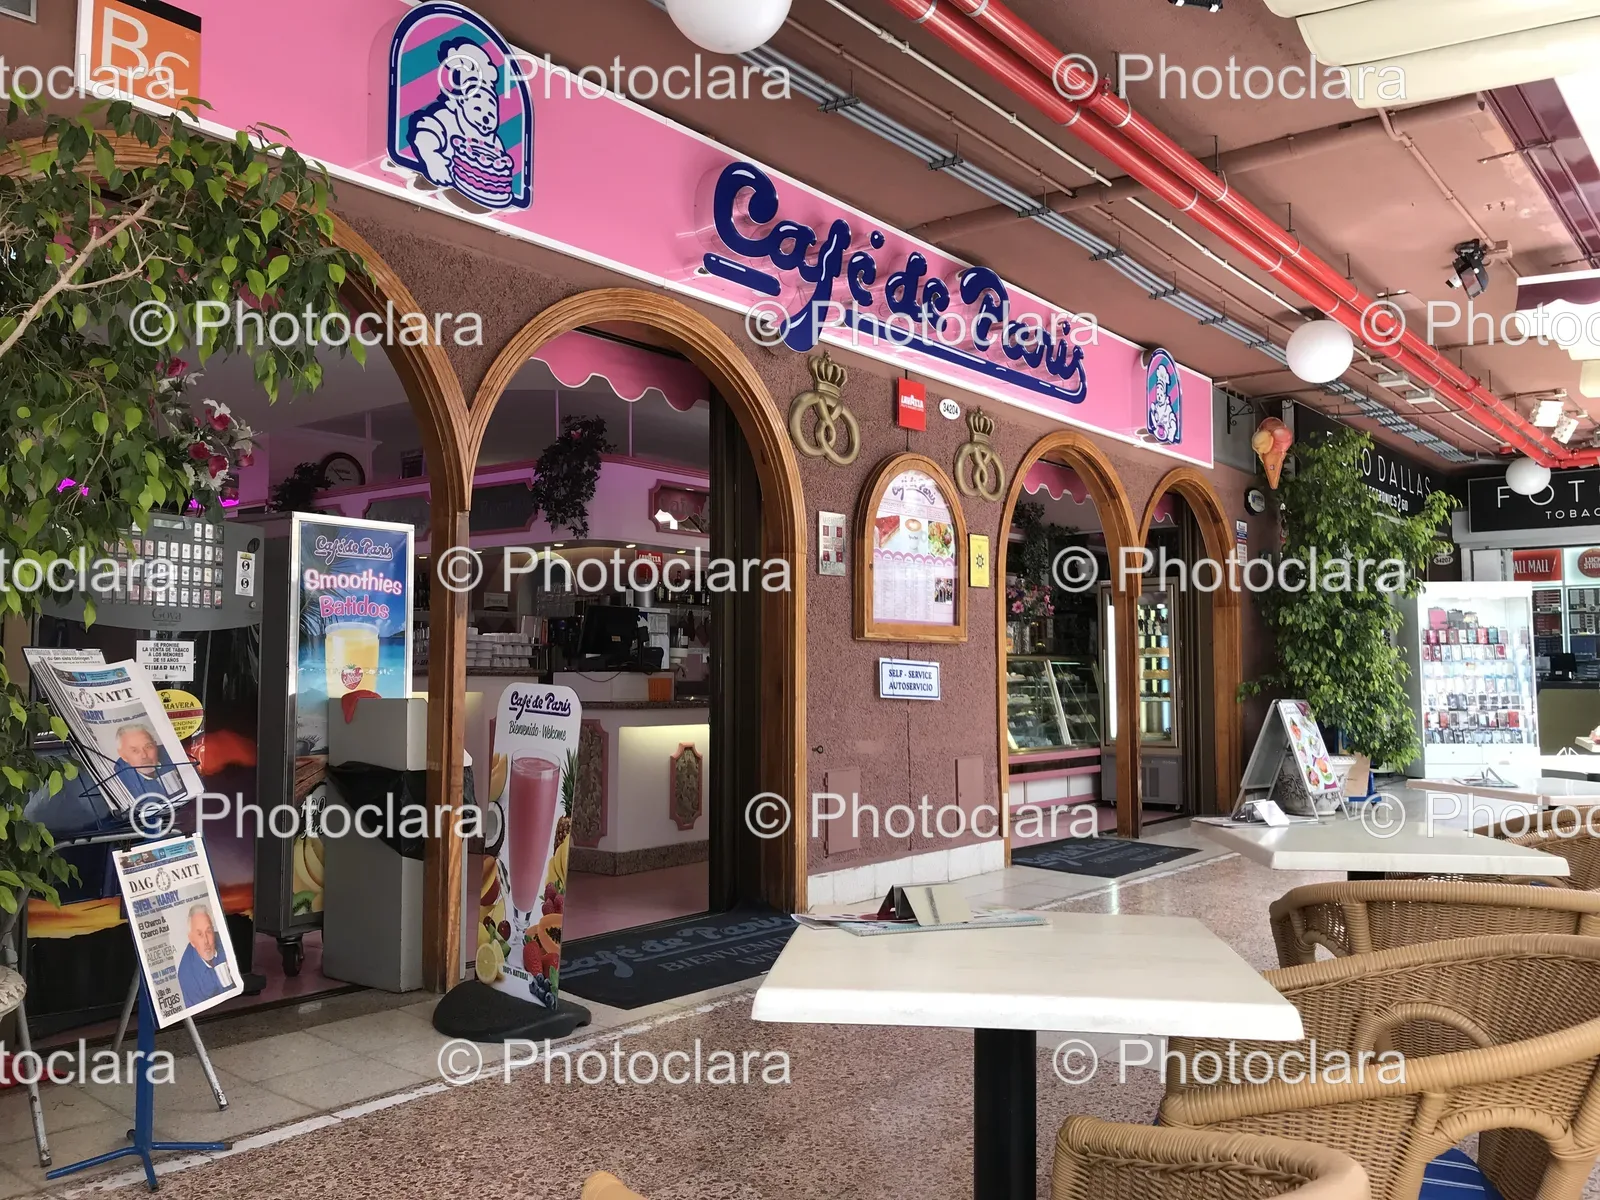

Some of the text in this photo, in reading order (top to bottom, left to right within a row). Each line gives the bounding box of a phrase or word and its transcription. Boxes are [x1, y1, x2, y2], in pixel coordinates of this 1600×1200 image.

[710, 161, 1085, 381] Café de Paris
[942, 402, 959, 415] 34204
[1378, 454, 1431, 499] DALLAS
[315, 535, 393, 565] Café de Paris
[1528, 559, 1550, 573] MALL
[304, 568, 403, 595] Smoothies
[319, 595, 390, 619] Batidos
[888, 668, 932, 680] SELF SERVICE
[888, 681, 933, 692] AUTOSERVICIO
[94, 687, 133, 704] NATT
[163, 701, 195, 709] MAVERA
[509, 690, 571, 720] Café de Paris
[542, 724, 567, 741] Welcome
[128, 876, 153, 893] DAG
[171, 863, 200, 882] NATT
[132, 890, 179, 913] SVEN HARRY
[513, 968, 529, 981] NATURAL
[158, 993, 181, 1010] Firgas
